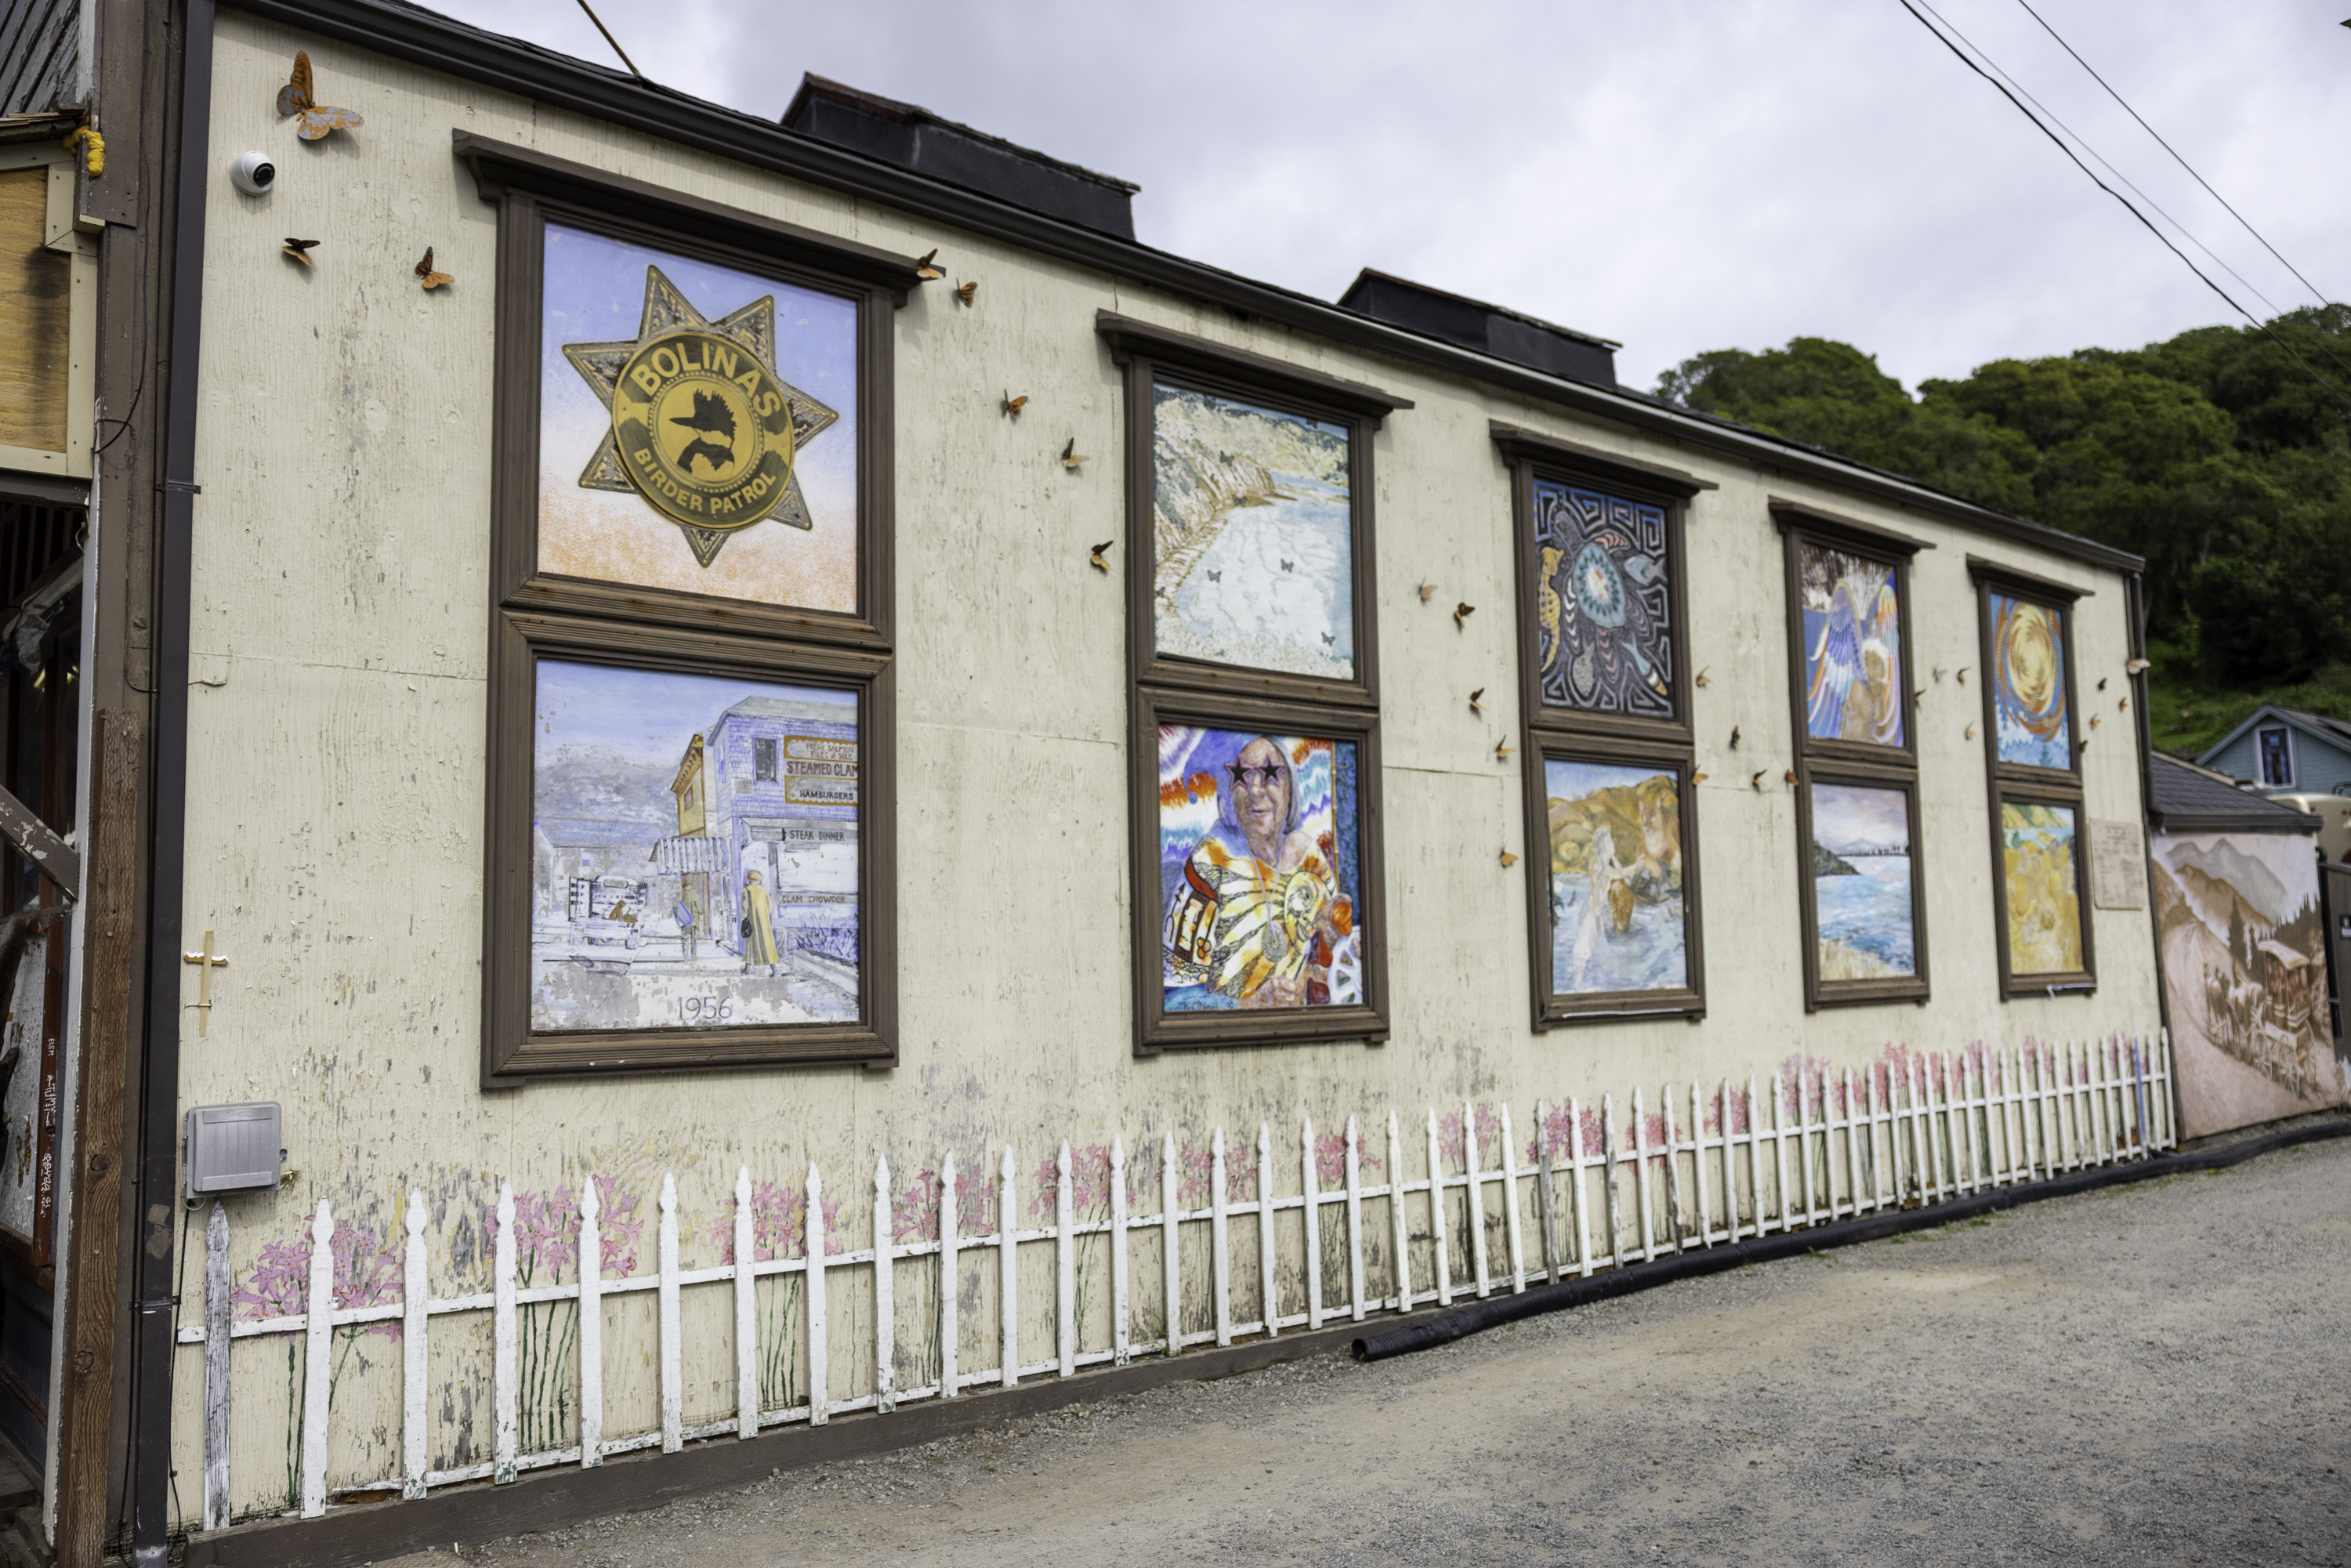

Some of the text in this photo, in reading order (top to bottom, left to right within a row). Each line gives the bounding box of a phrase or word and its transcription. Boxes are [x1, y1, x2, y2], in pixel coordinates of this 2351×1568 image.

[630, 342, 781, 417] BOLINAS
[633, 447, 777, 514] BIRDER PATROL
[806, 743, 853, 753] FRESH SALMON
[810, 750, 828, 759] FILET
[838, 752, 853, 761] SOLE
[787, 761, 832, 776] STEAMED
[799, 790, 853, 800] HAMBURGERS
[789, 830, 845, 842] STEAK DINNER
[781, 895, 803, 904] CLAM
[677, 996, 732, 1020] 1956
